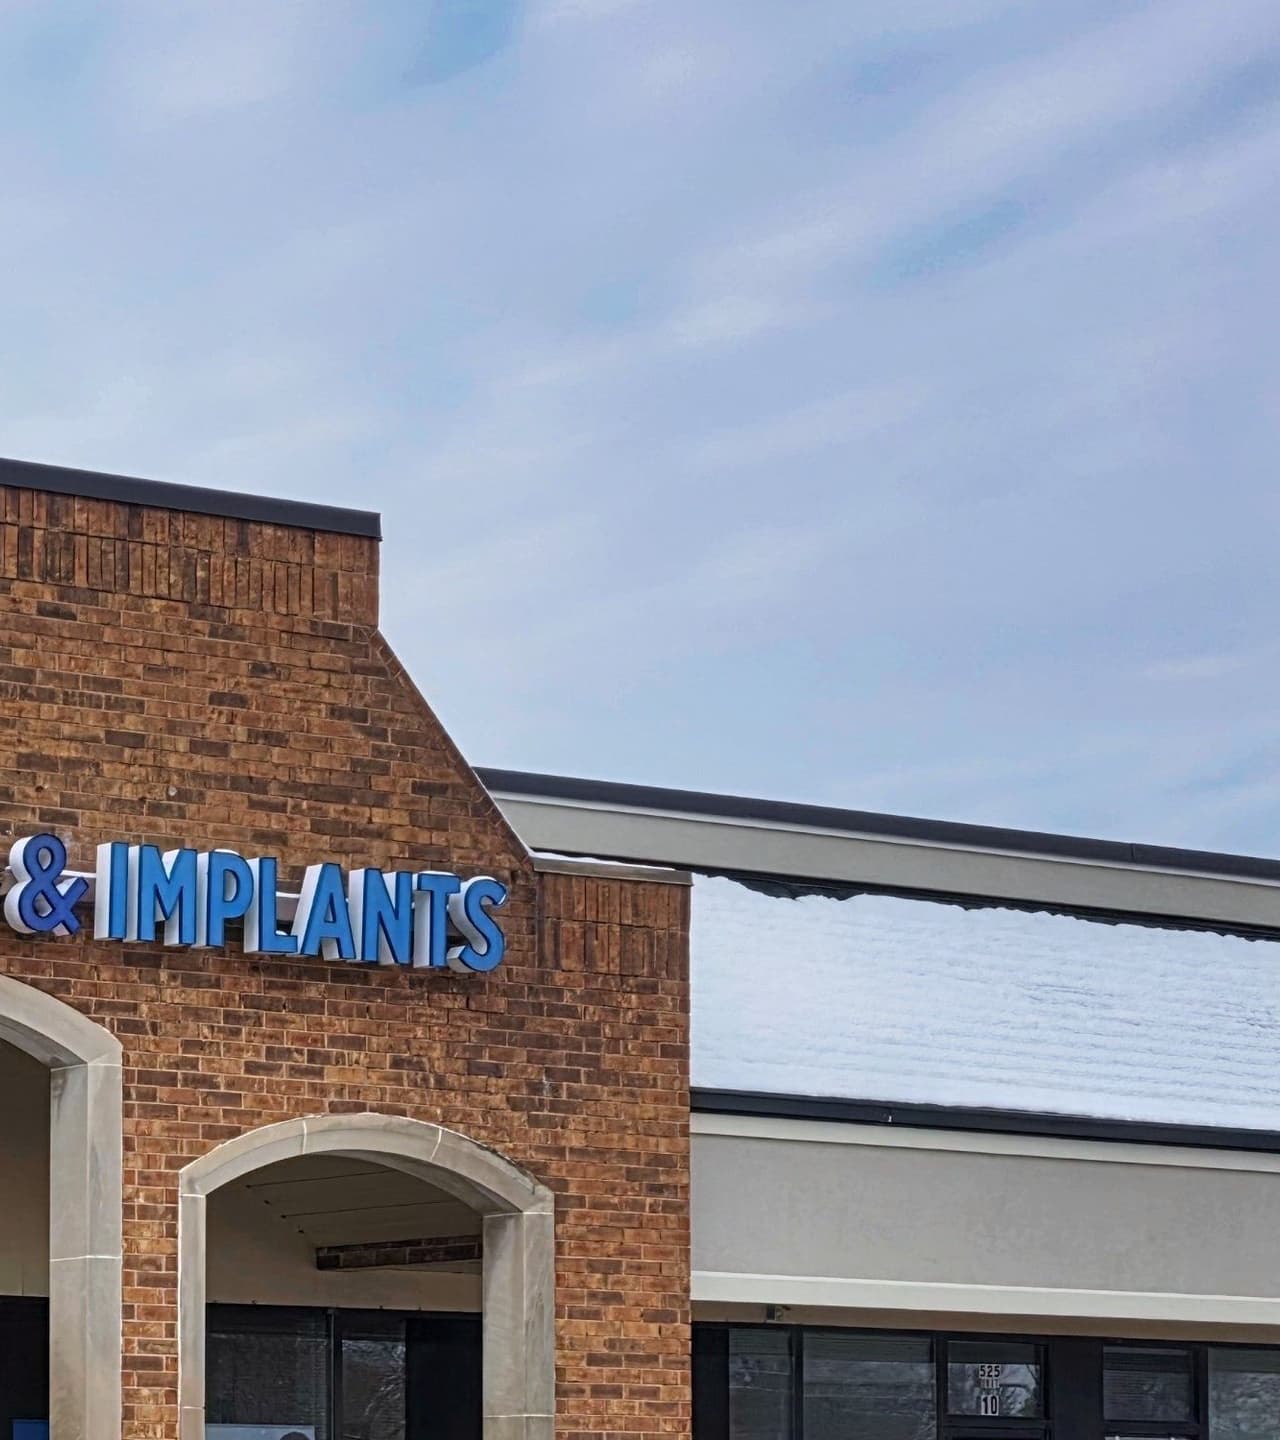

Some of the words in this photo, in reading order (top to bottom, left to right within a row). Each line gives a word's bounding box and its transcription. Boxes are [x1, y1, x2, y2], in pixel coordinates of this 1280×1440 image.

[5, 832, 89, 936] &
[93, 840, 508, 973] IMPLANTS
[980, 1365, 1000, 1378] 525
[982, 1395, 998, 1415] 10
